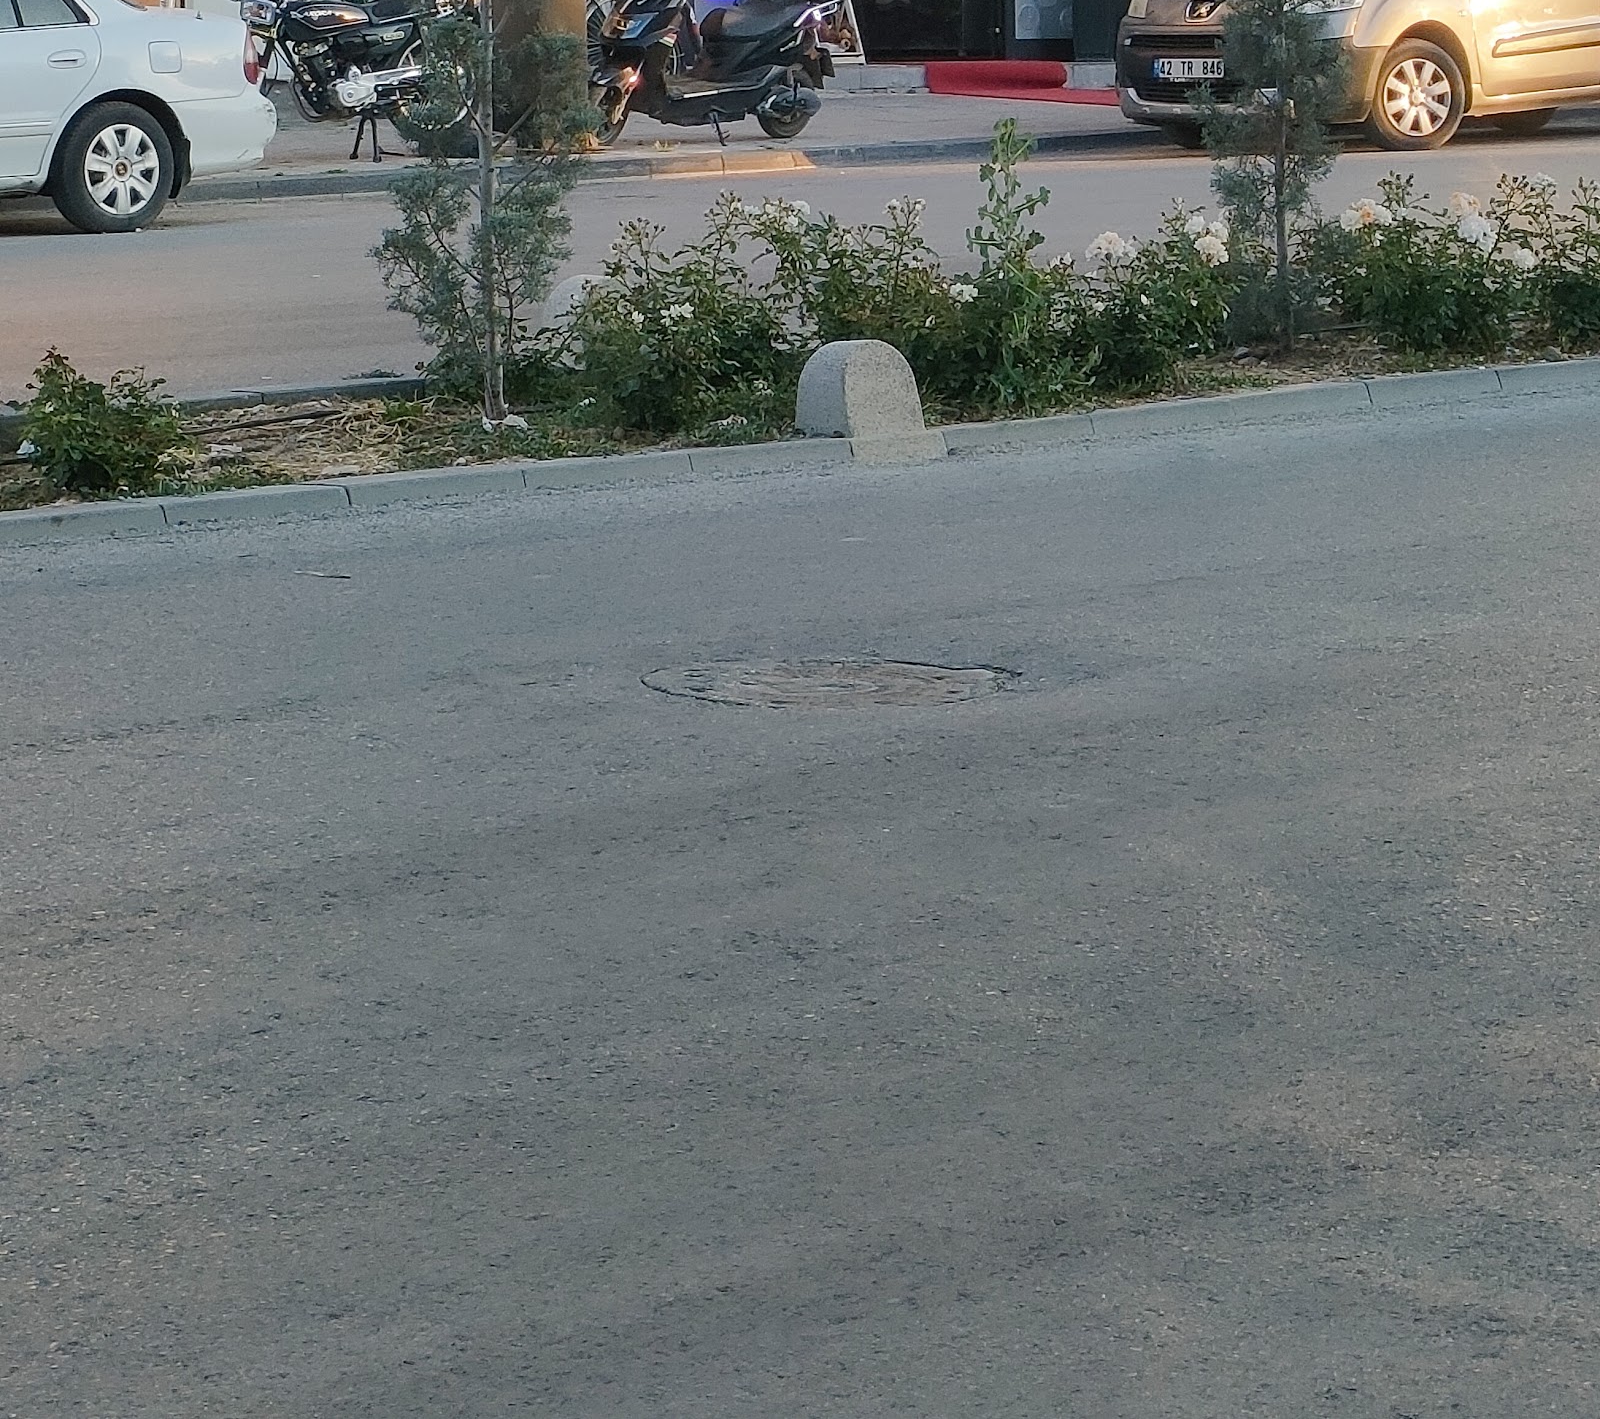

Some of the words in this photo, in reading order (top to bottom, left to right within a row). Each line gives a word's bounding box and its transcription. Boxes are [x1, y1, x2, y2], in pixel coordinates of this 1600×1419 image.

[1160, 60, 1173, 75] 42
[1181, 60, 1193, 75] TR
[1202, 60, 1222, 75] 846
